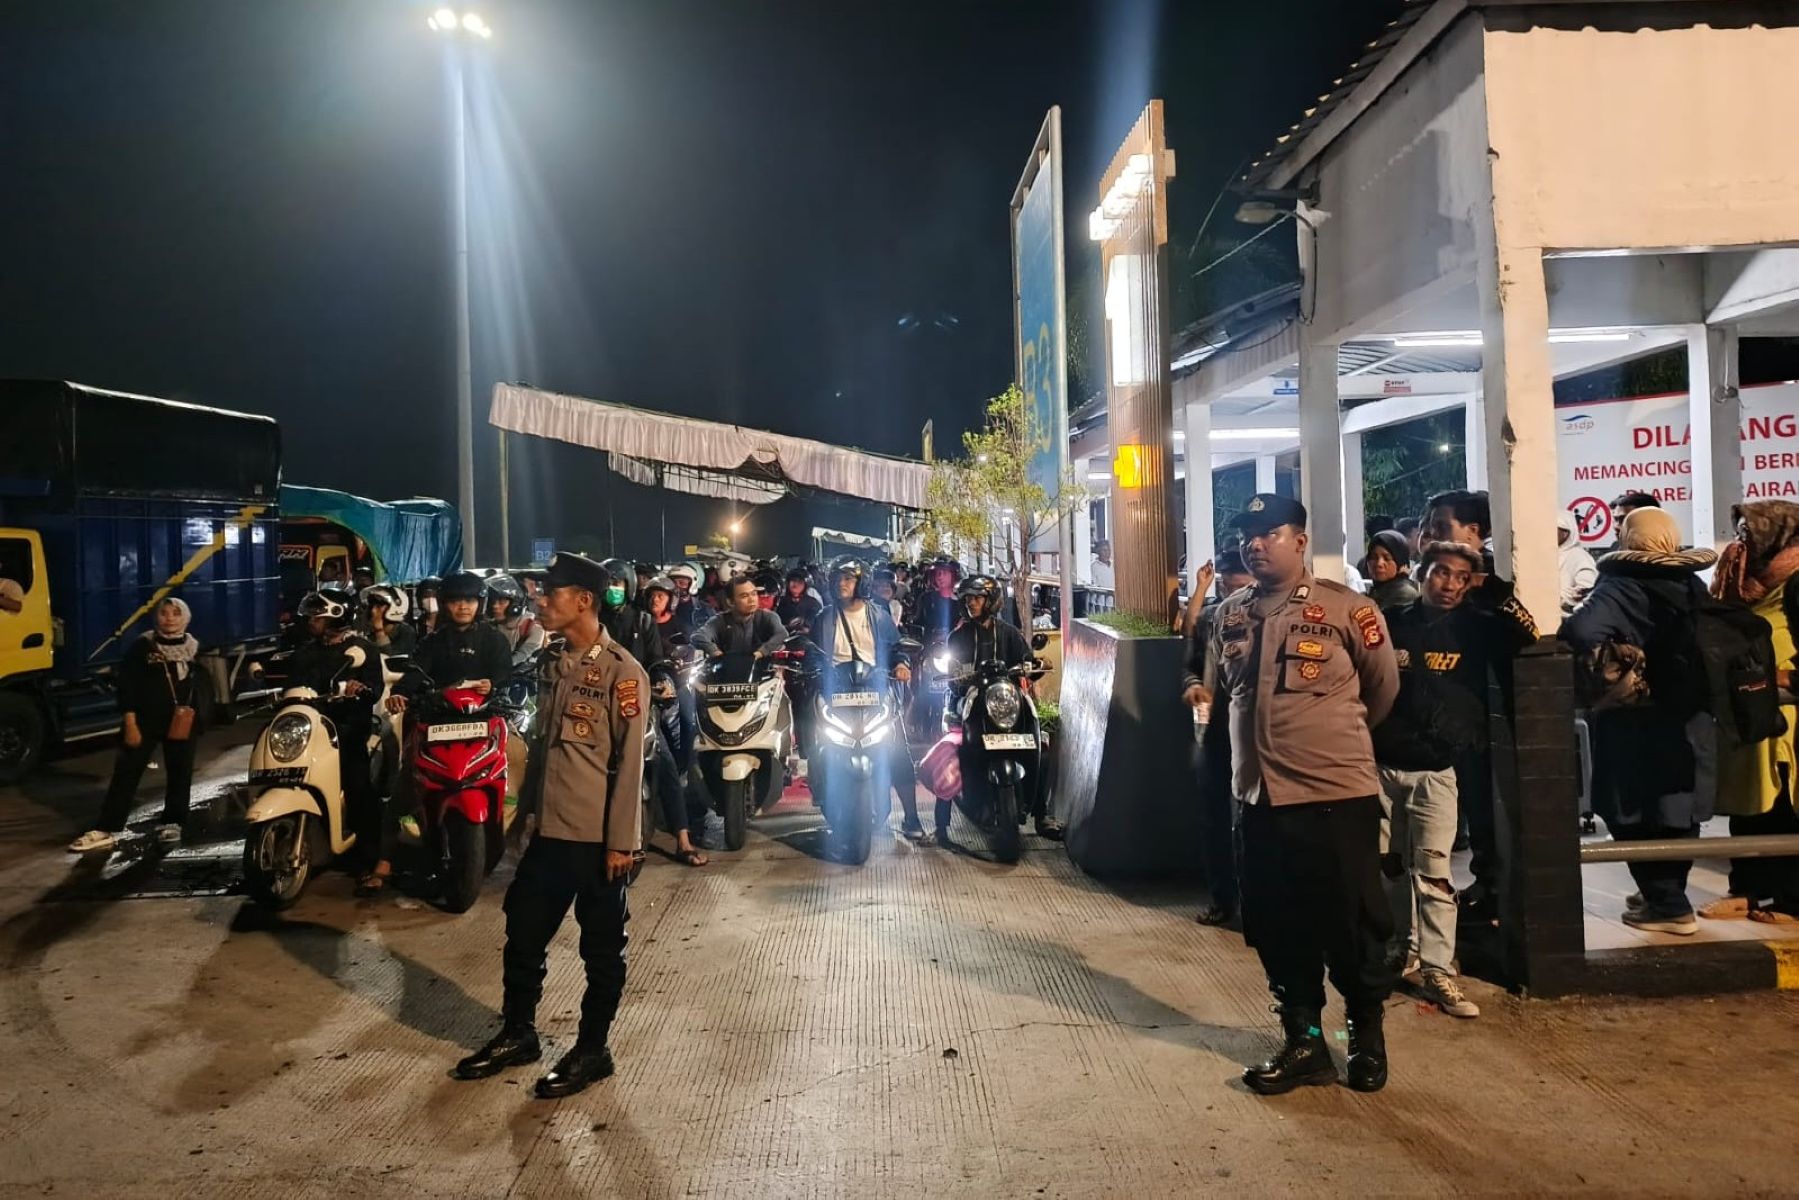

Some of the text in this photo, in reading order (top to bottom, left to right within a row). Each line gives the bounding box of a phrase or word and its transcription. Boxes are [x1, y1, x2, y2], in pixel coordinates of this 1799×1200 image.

[1633, 415, 1796, 448] DILNG
[1575, 460, 1691, 480] MEMANCING
[1755, 453, 1799, 470] BER
[1652, 487, 1692, 501] ARE
[1747, 481, 1798, 497] AIRA
[1290, 624, 1332, 638] POLRI
[572, 686, 605, 699] POLRI
